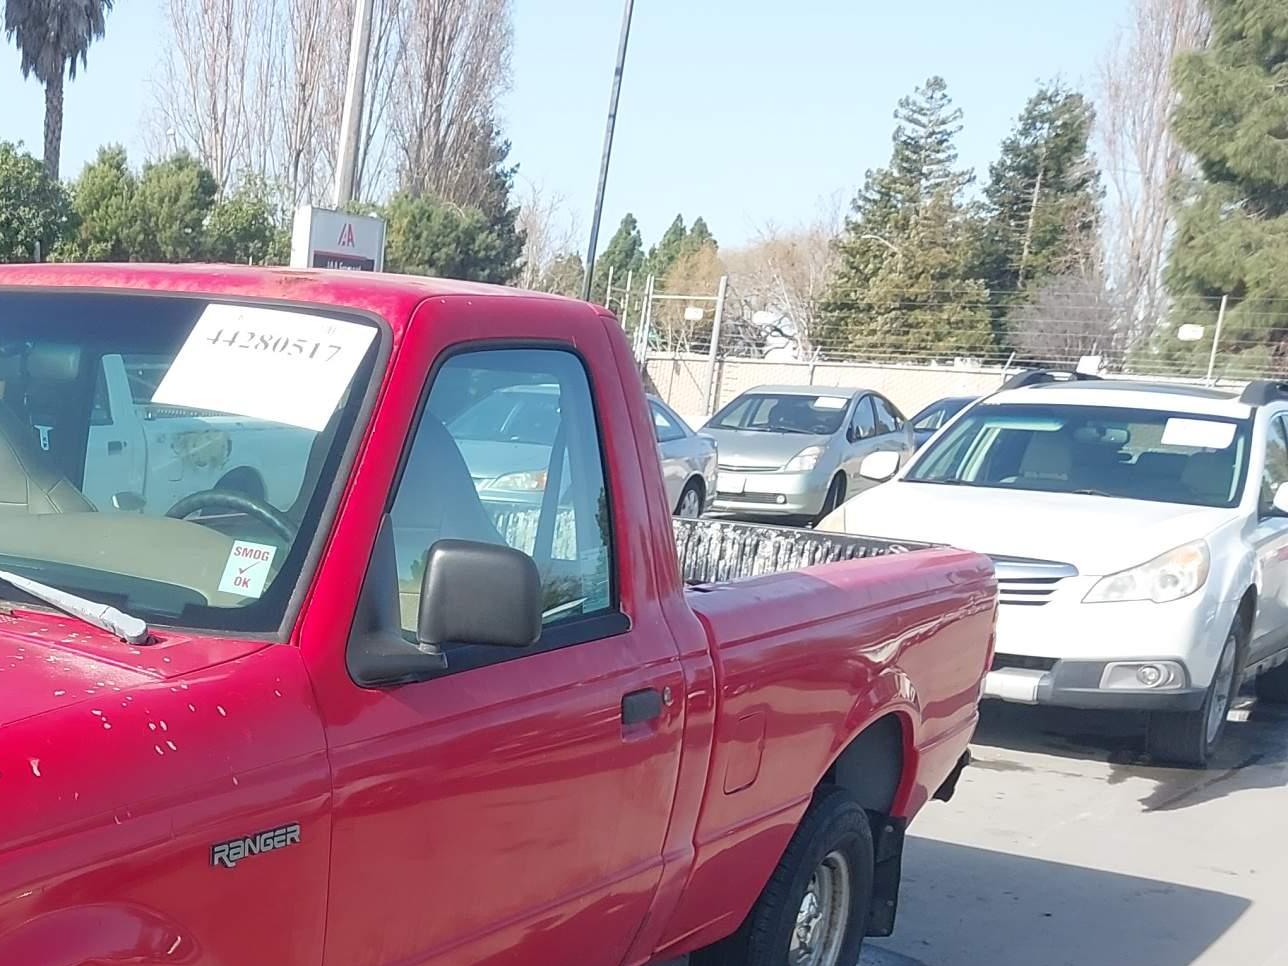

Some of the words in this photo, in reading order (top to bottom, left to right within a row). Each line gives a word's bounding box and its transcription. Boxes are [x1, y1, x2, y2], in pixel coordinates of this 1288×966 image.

[206, 328, 342, 362] 44280517
[233, 546, 270, 561] SMOG
[233, 576, 251, 589] OK
